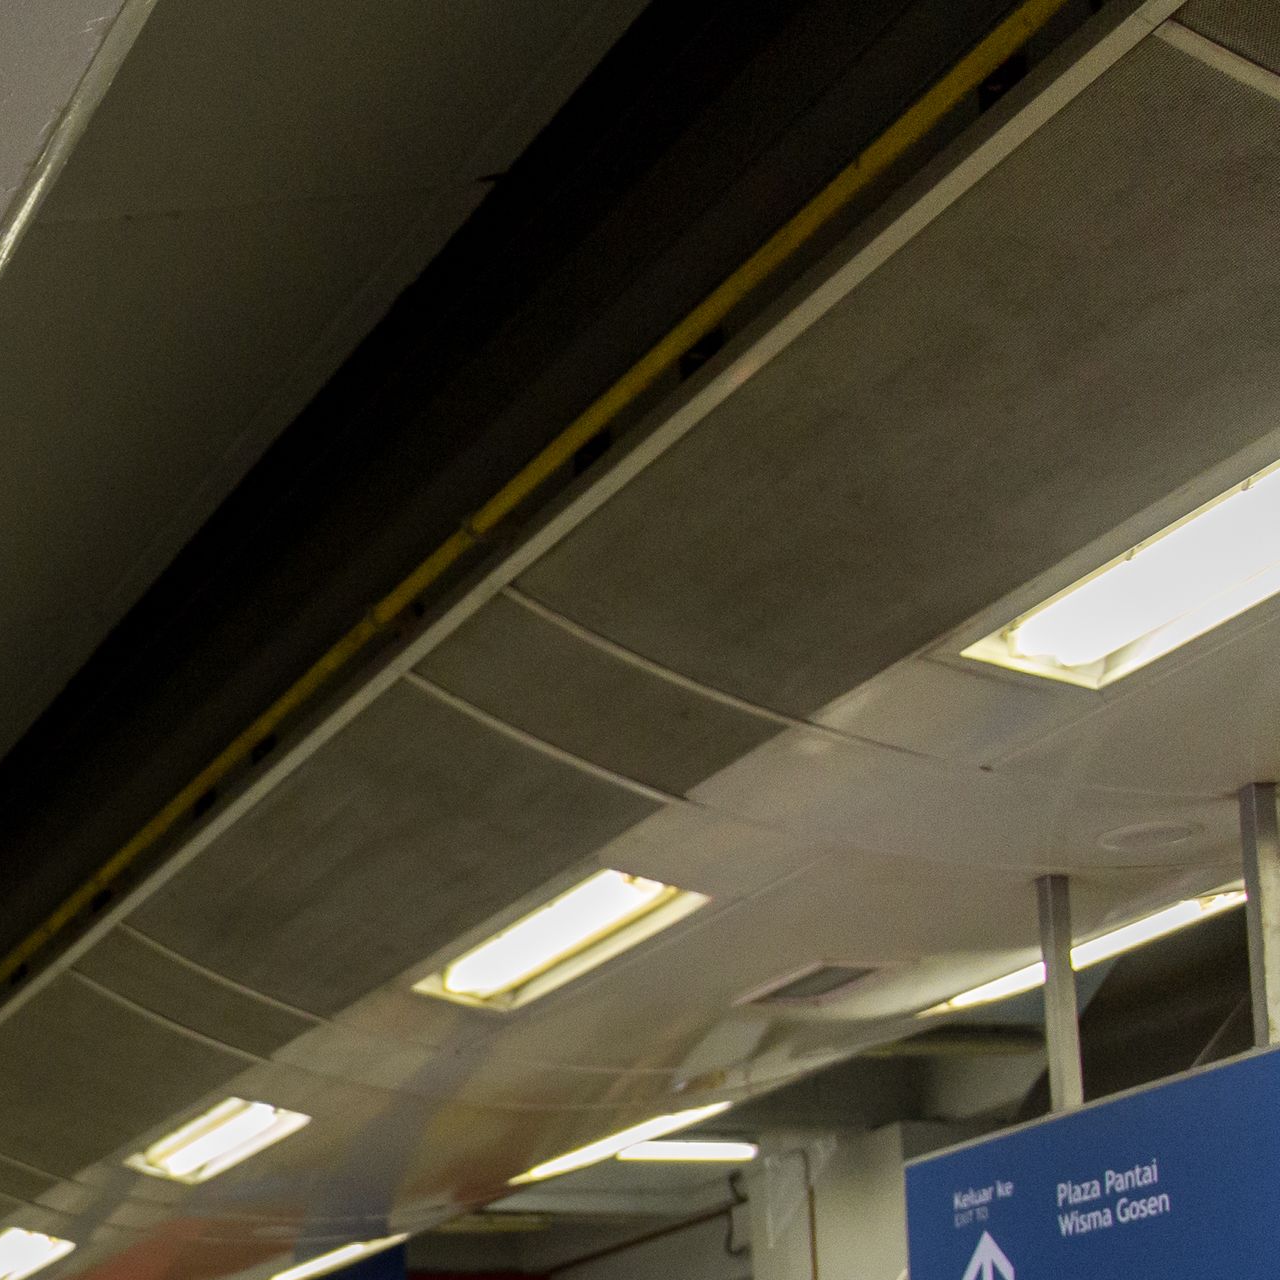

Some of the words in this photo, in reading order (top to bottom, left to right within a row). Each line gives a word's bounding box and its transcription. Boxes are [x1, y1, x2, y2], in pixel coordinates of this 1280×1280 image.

[954, 1186, 994, 1210] Keluar
[995, 1180, 1014, 1198] ke
[1057, 1179, 1101, 1207] Plaza
[1105, 1158, 1158, 1194] Pantai
[1058, 1208, 1112, 1237] Wisma
[1117, 1193, 1170, 1223] Gosen
